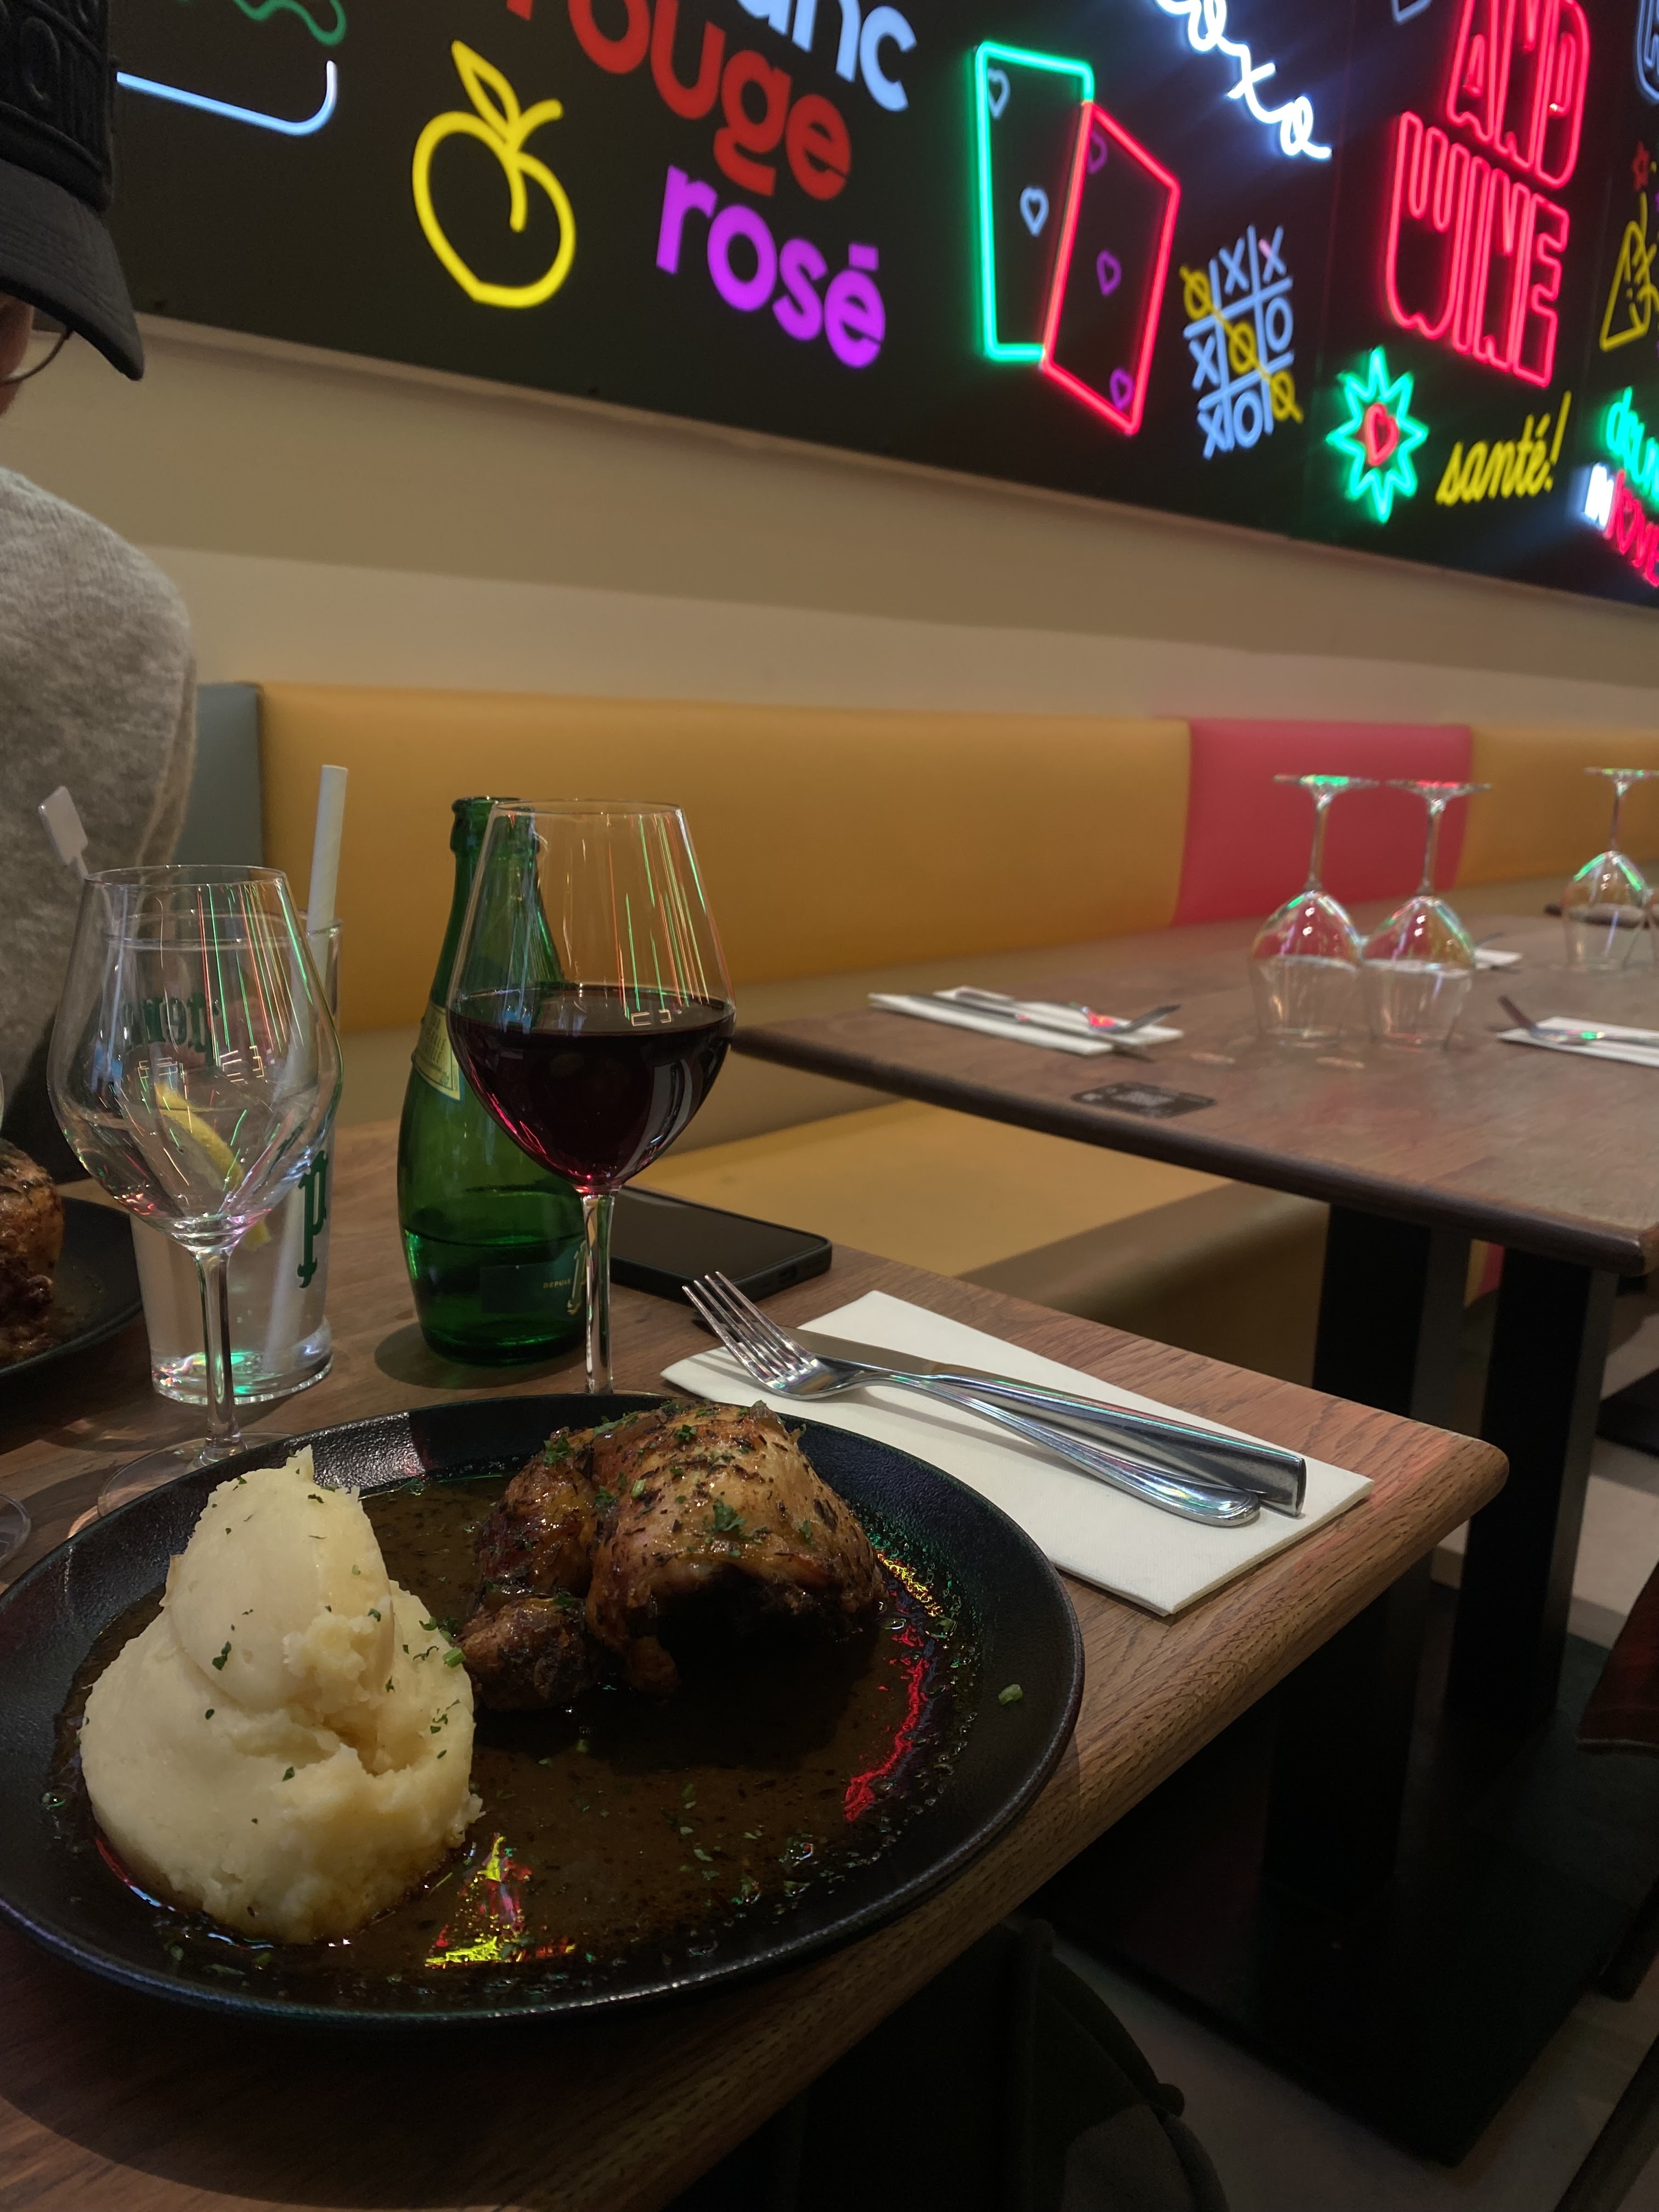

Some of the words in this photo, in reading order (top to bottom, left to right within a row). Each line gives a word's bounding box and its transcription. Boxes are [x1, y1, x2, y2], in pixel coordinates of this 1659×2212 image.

[506, 0, 852, 201] ouge
[656, 165, 886, 369] rosé
[1435, 390, 1572, 507] santé!
[543, 1278, 571, 1289] DEPUIS
